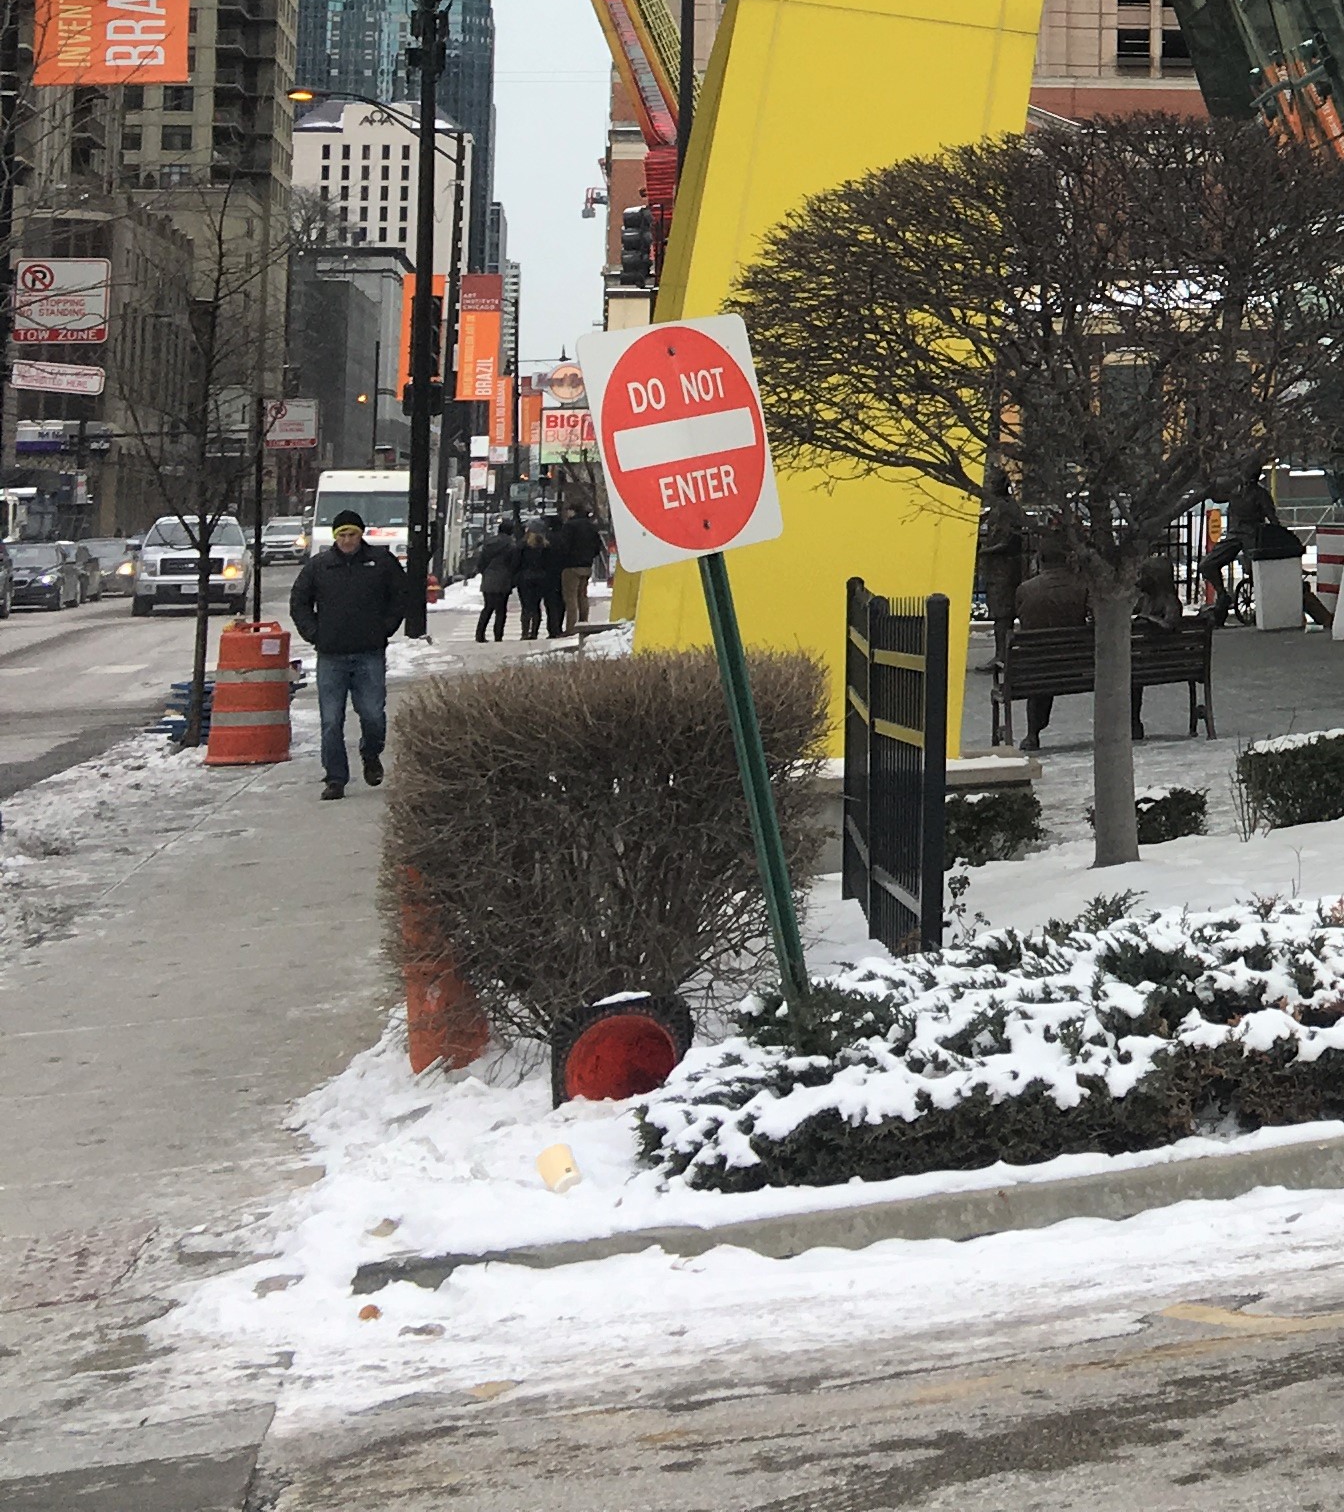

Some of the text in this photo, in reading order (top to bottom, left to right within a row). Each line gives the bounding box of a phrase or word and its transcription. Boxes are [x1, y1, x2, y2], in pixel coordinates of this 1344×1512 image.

[39, 298, 86, 307] STOPPING
[39, 308, 86, 317] STANDING
[17, 330, 50, 341] TOW
[475, 356, 494, 396] BRAZIL
[626, 377, 666, 414] DO
[679, 367, 725, 405] NOT
[545, 414, 579, 429] BIG
[658, 464, 739, 510] ENTER
